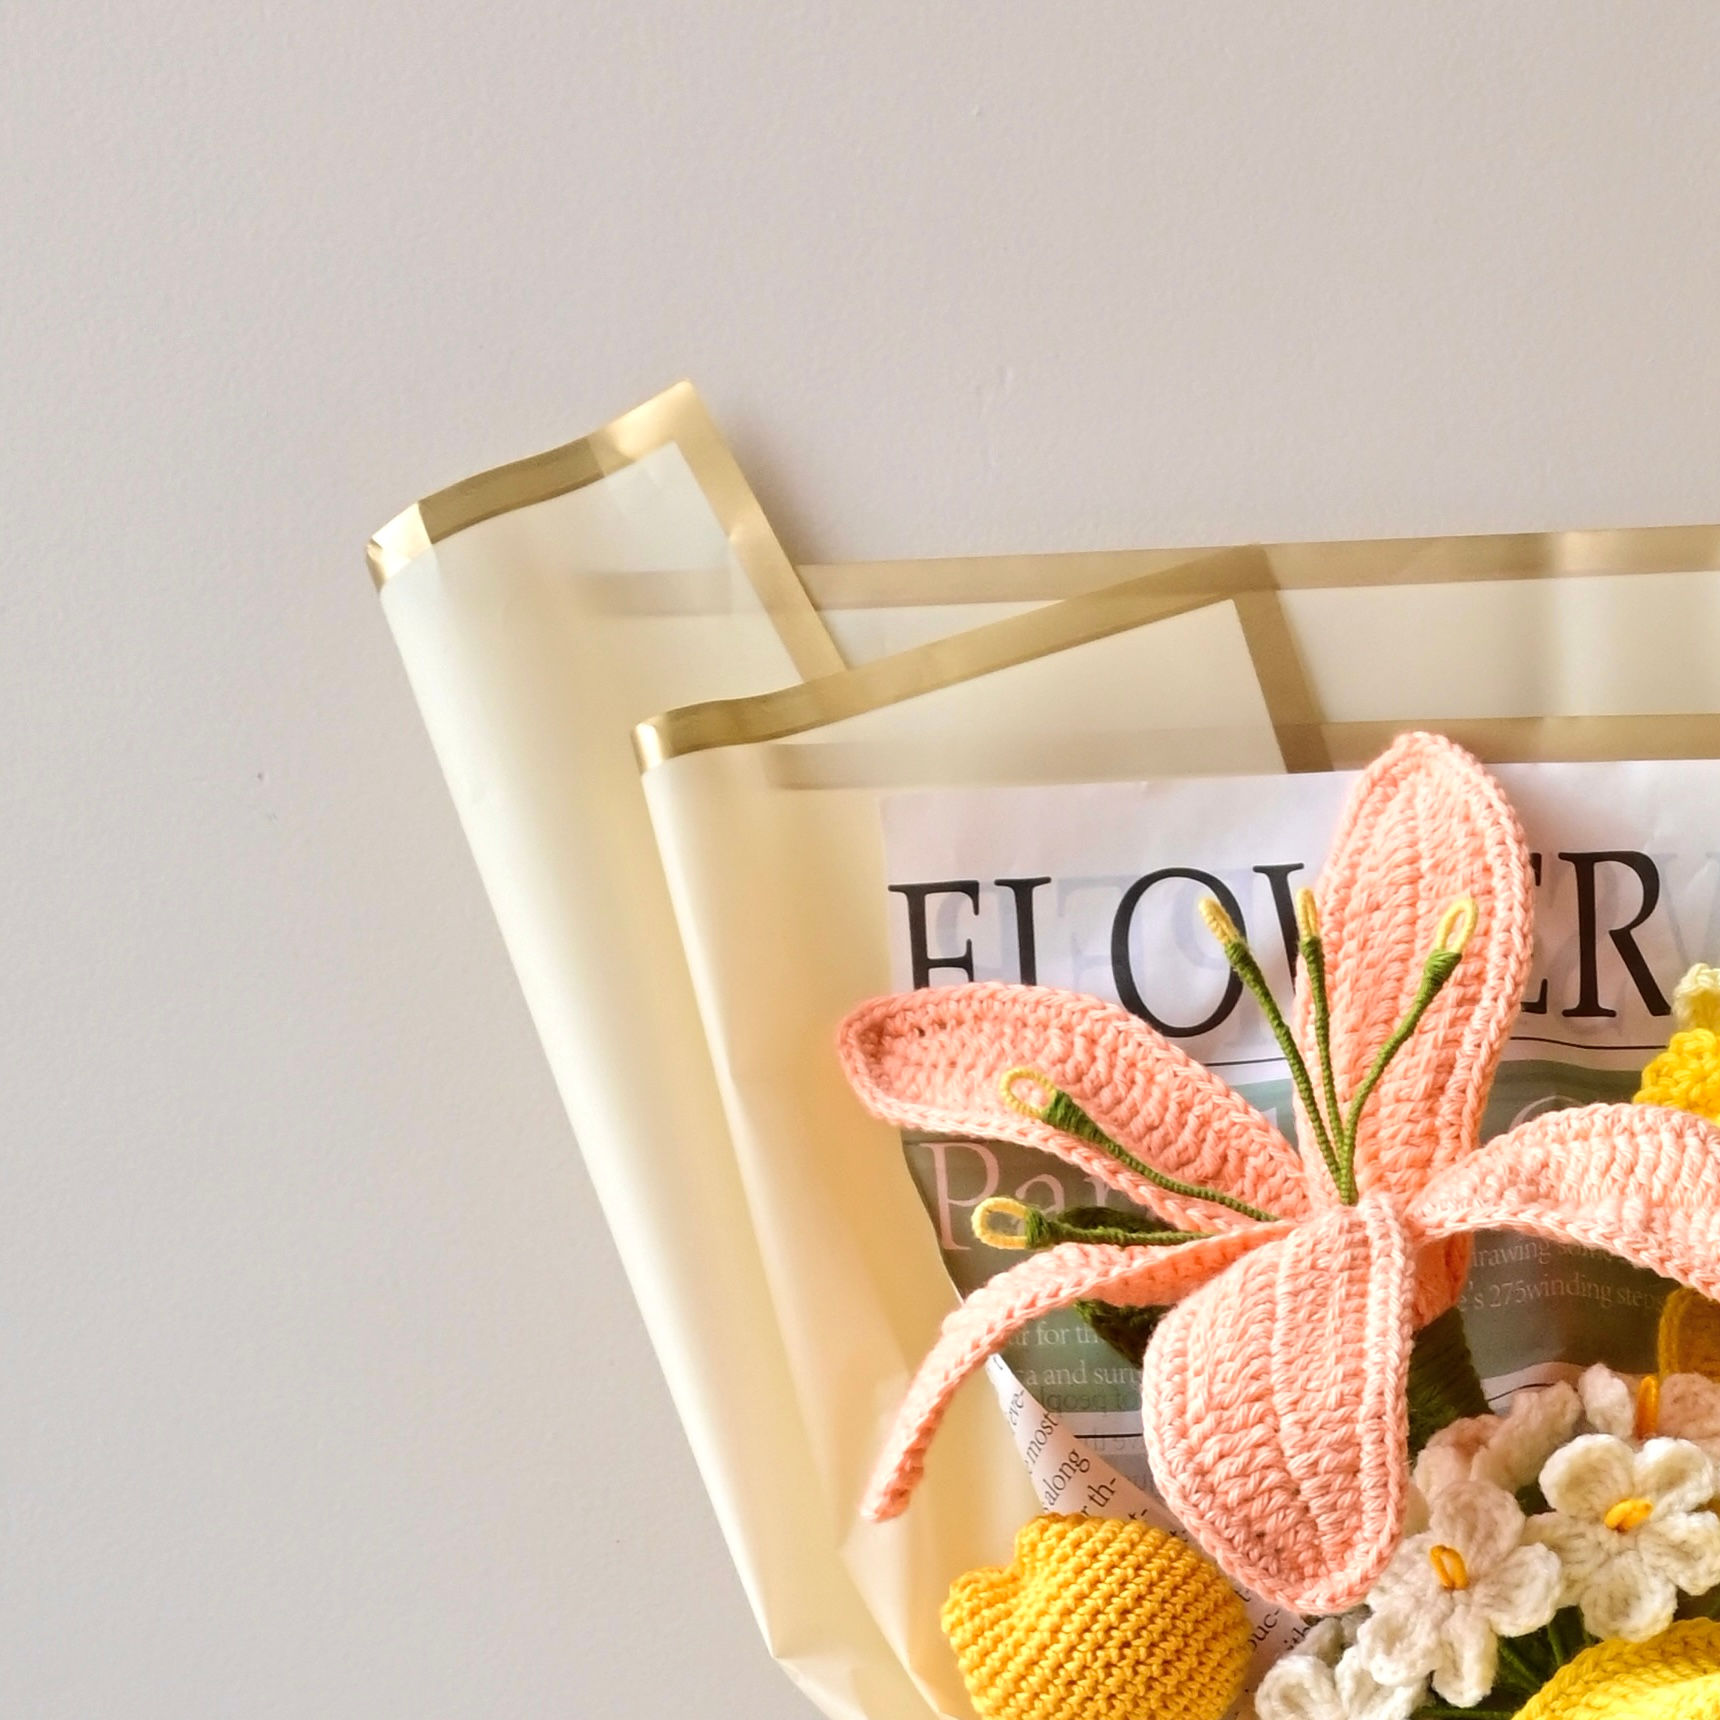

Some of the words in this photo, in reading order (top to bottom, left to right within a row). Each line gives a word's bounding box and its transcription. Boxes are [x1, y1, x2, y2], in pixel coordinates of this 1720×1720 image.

[1036, 1321, 1071, 1346] for
[1044, 1360, 1089, 1386] and
[1043, 1448, 1091, 1507] along
[1089, 1478, 1117, 1508] th-
